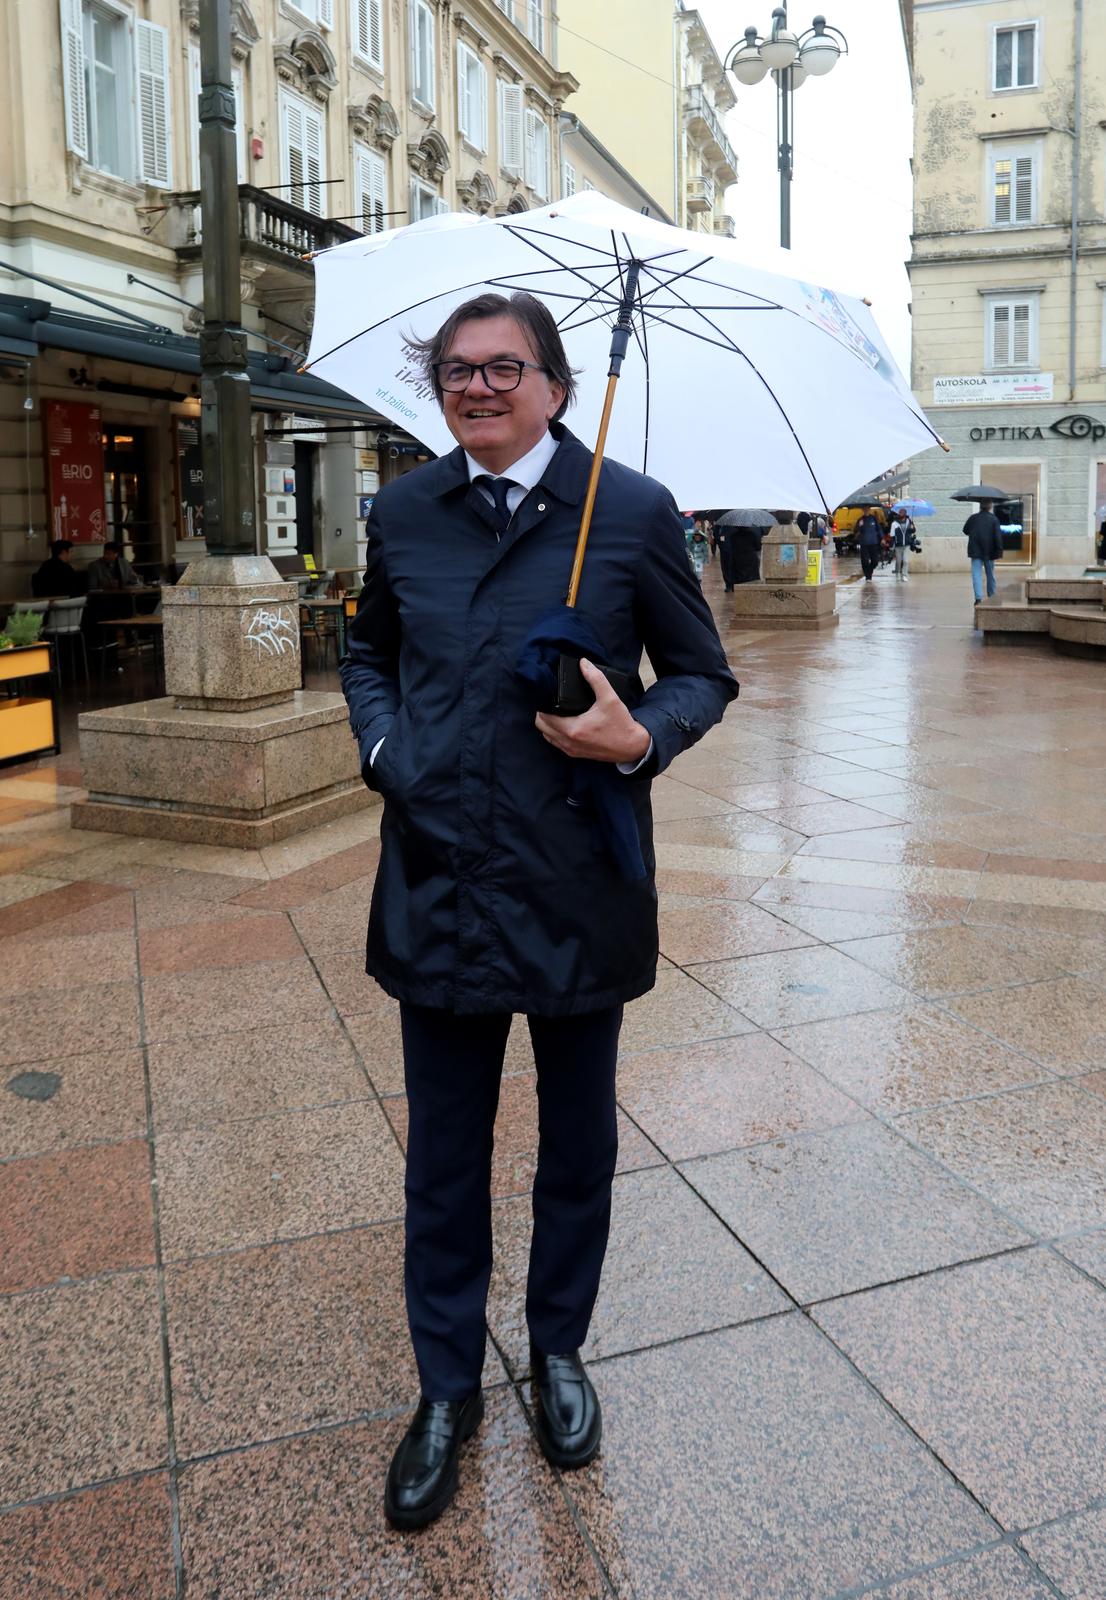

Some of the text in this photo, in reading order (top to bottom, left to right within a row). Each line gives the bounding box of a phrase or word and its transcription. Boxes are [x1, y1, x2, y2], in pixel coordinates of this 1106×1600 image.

[936, 378, 987, 387] AUTOŠKOLA
[970, 426, 1044, 441] OPTIKA
[71, 464, 93, 480] RIO
